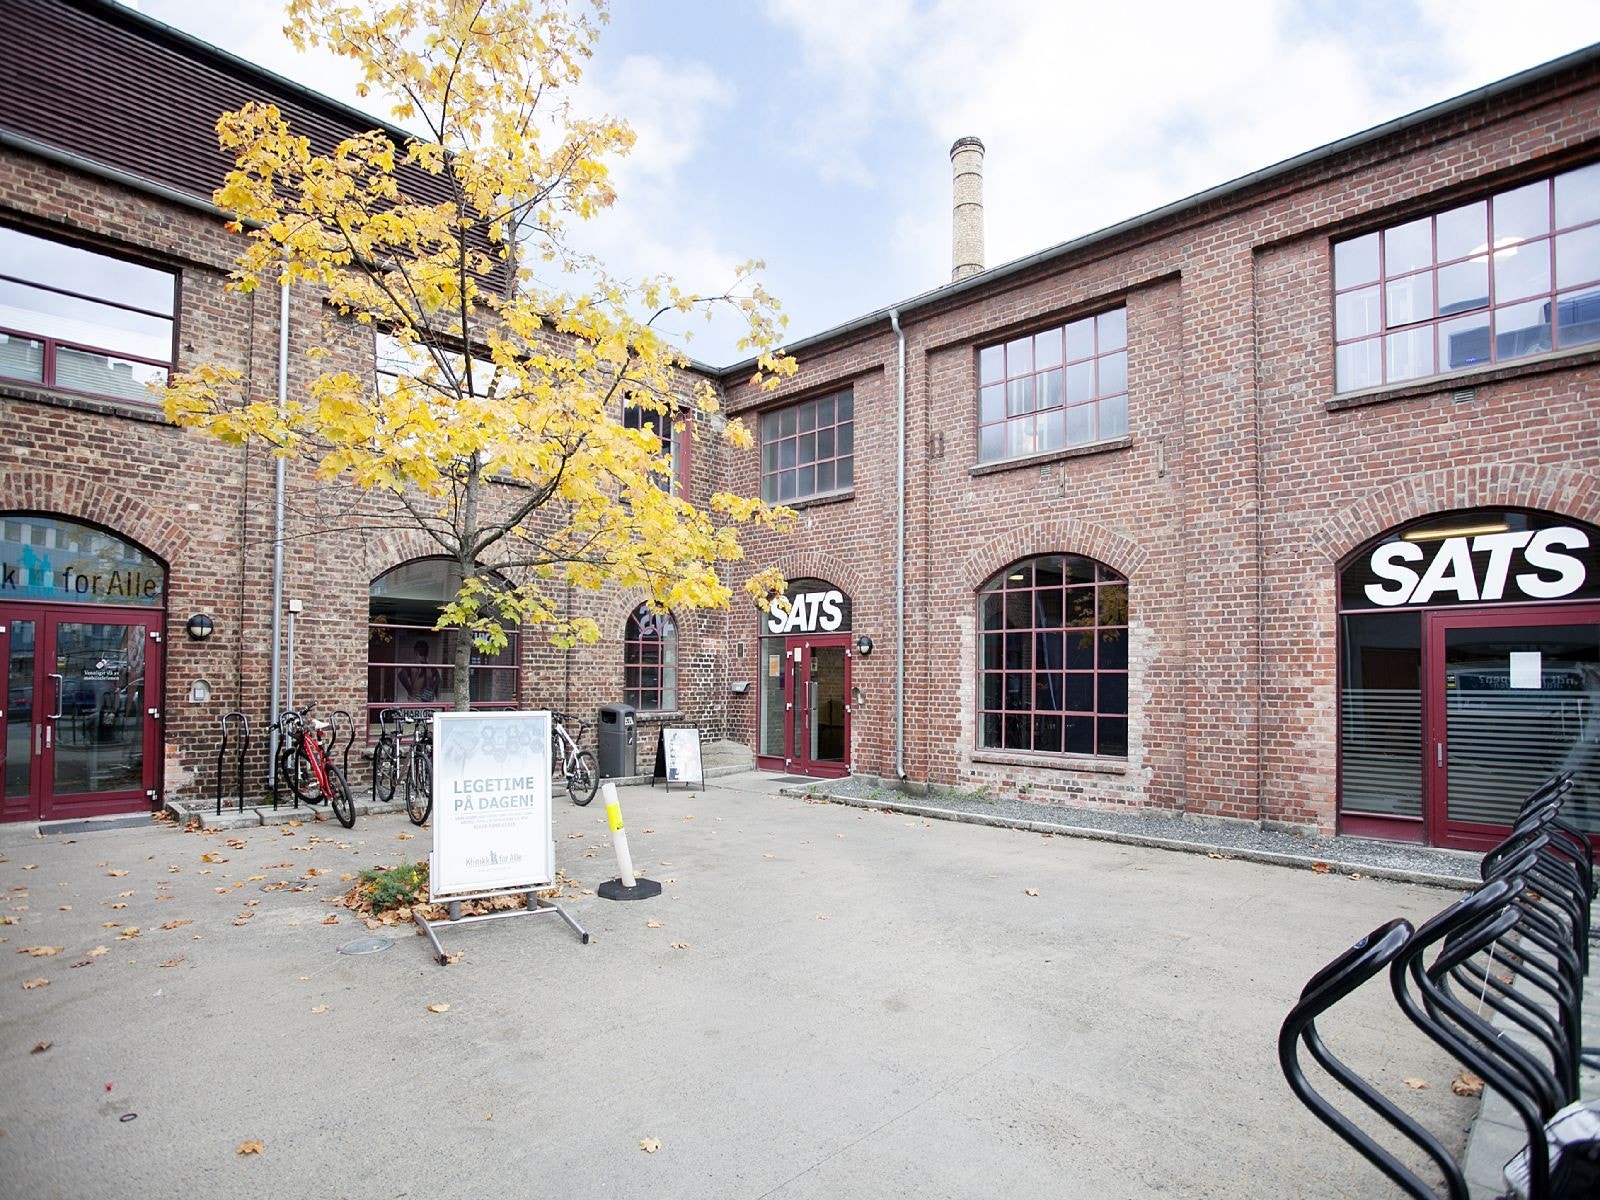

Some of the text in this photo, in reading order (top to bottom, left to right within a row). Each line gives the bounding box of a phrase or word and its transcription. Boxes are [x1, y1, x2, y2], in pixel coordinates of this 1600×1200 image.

[1364, 526, 1590, 607] SATS
[62, 566, 102, 594] for
[106, 570, 156, 598] Alle
[768, 590, 844, 634] SATS
[454, 776, 534, 794] LEGETIME
[454, 794, 534, 812] PÅ DAGEN!
[465, 855, 490, 867] Klinikk
[499, 855, 508, 863] for
